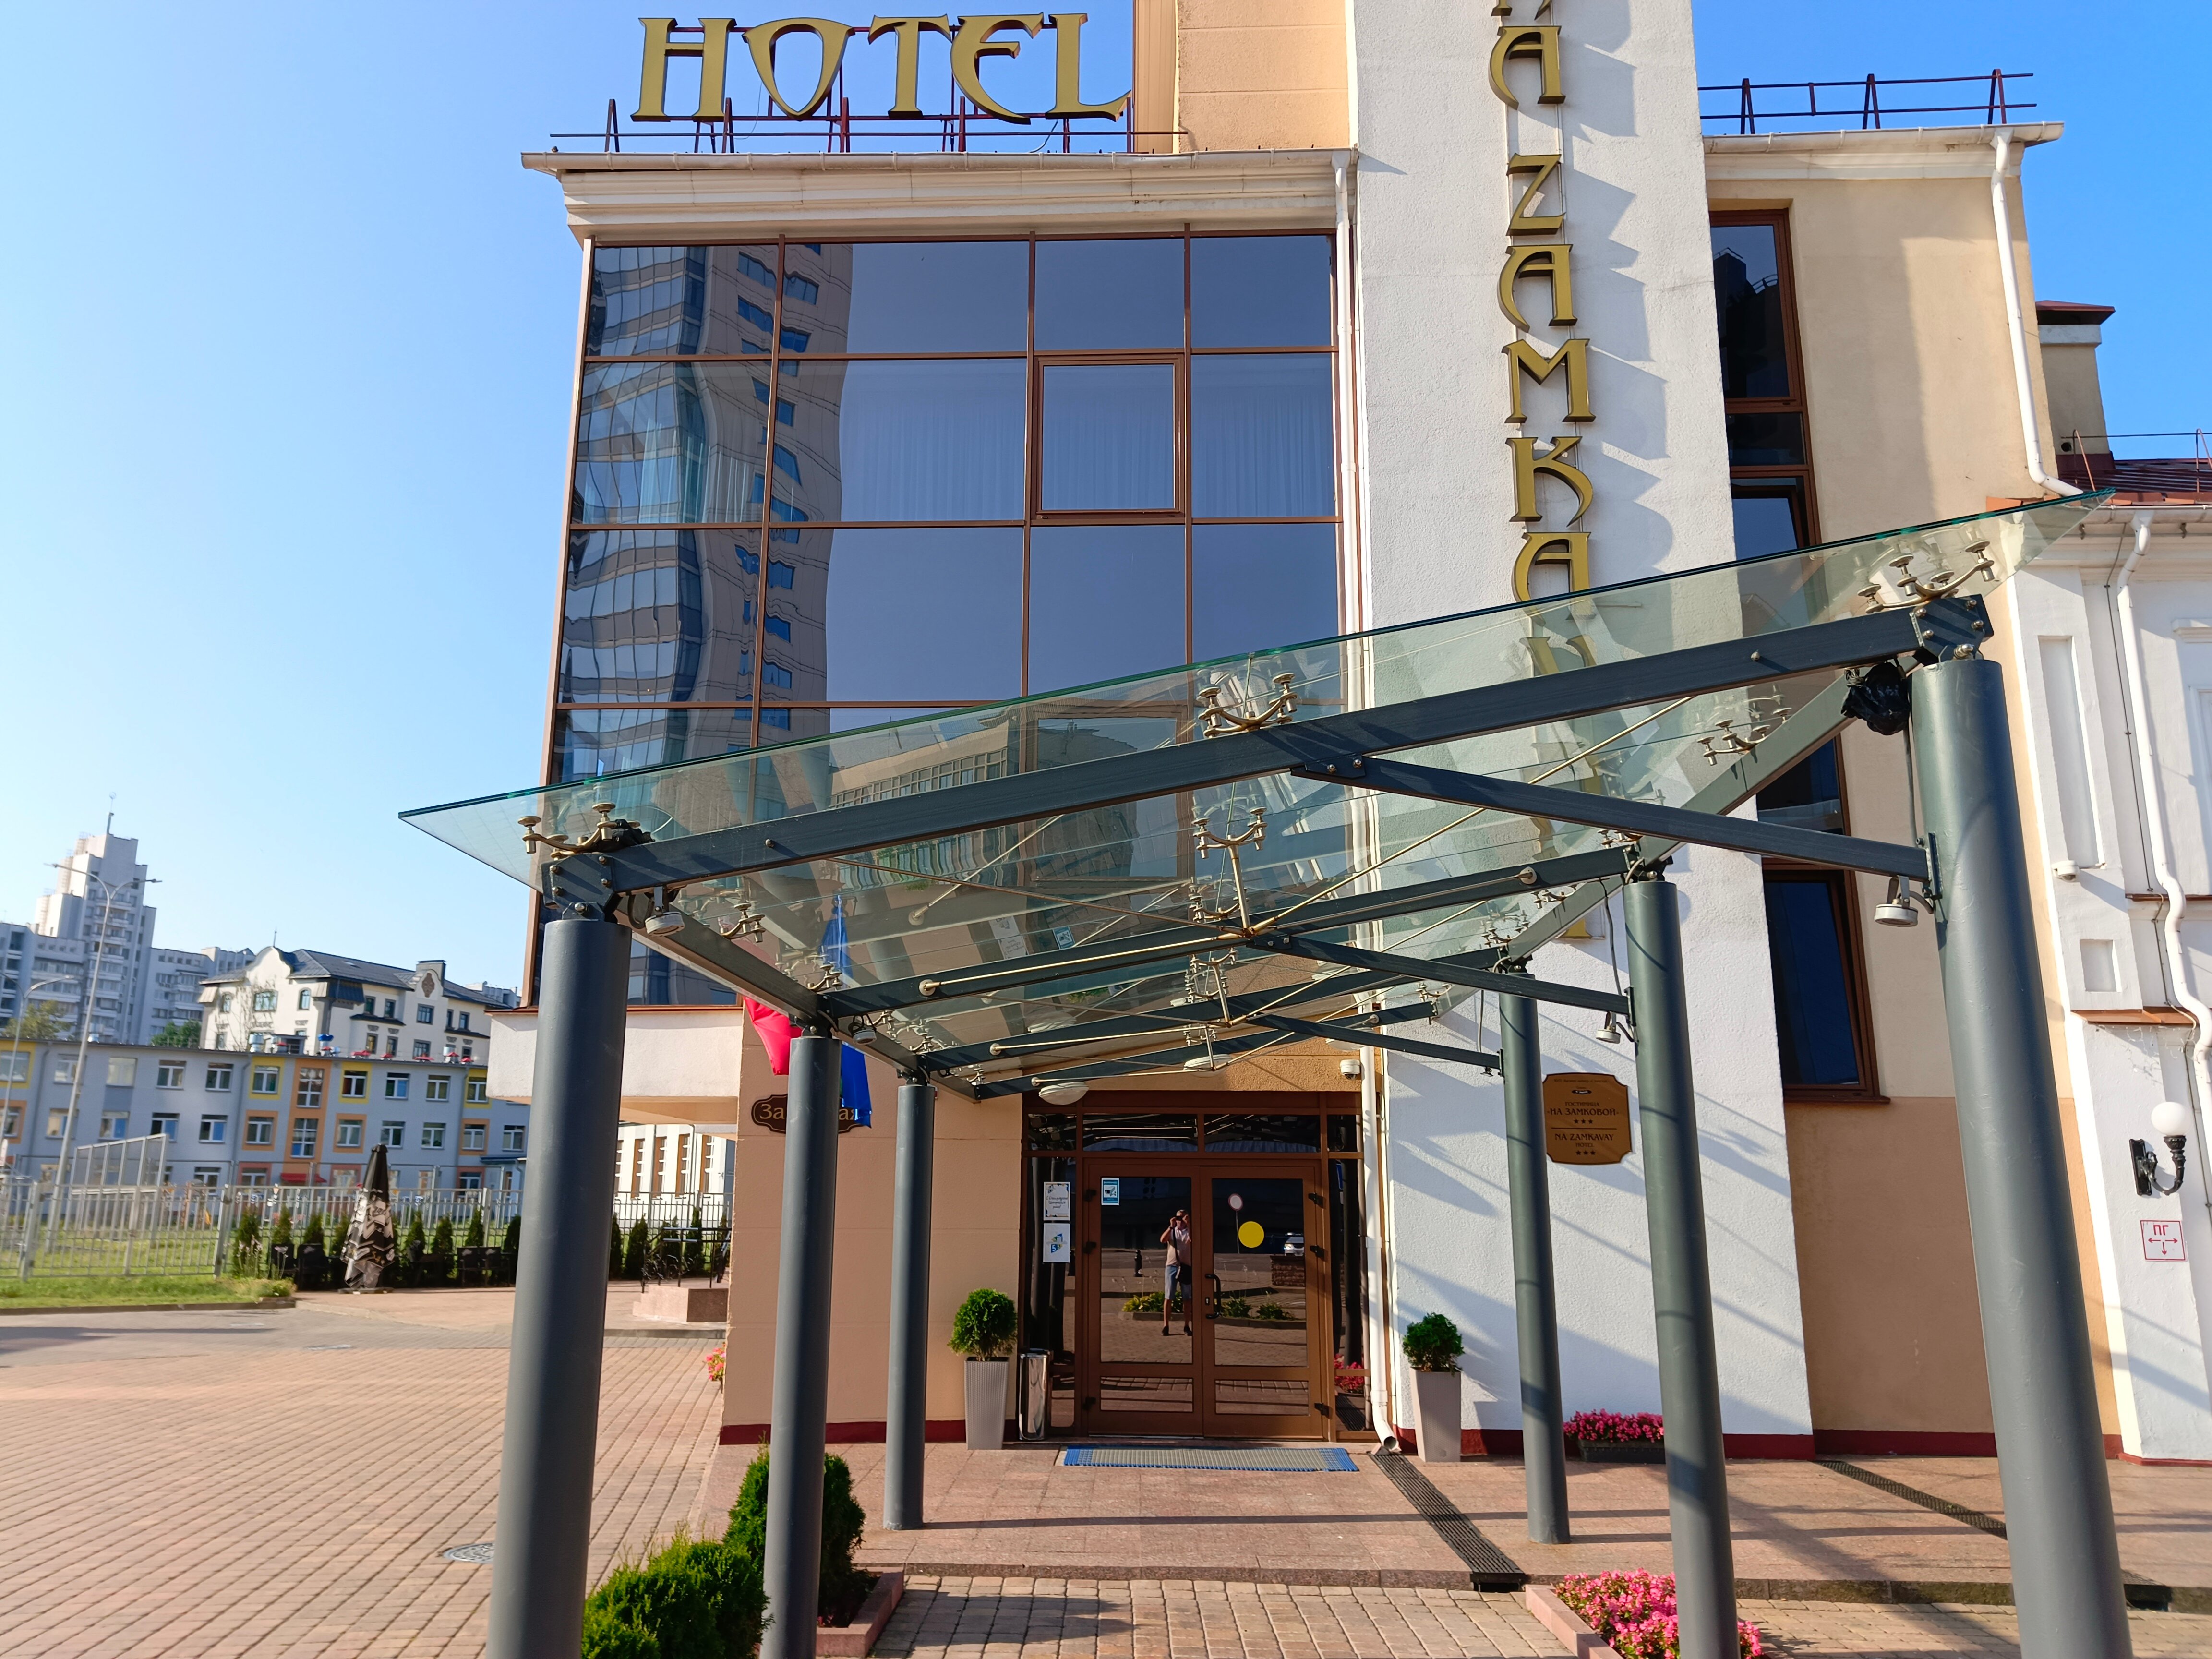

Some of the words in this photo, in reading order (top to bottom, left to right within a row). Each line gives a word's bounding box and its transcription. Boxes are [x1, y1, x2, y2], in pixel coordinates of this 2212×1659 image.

[630, 12, 1131, 125] HOTEL
[1488, 0, 1566, 110] A
[1497, 153, 1603, 939] ZAMKA
[2153, 1225, 2168, 1235] ПГ
